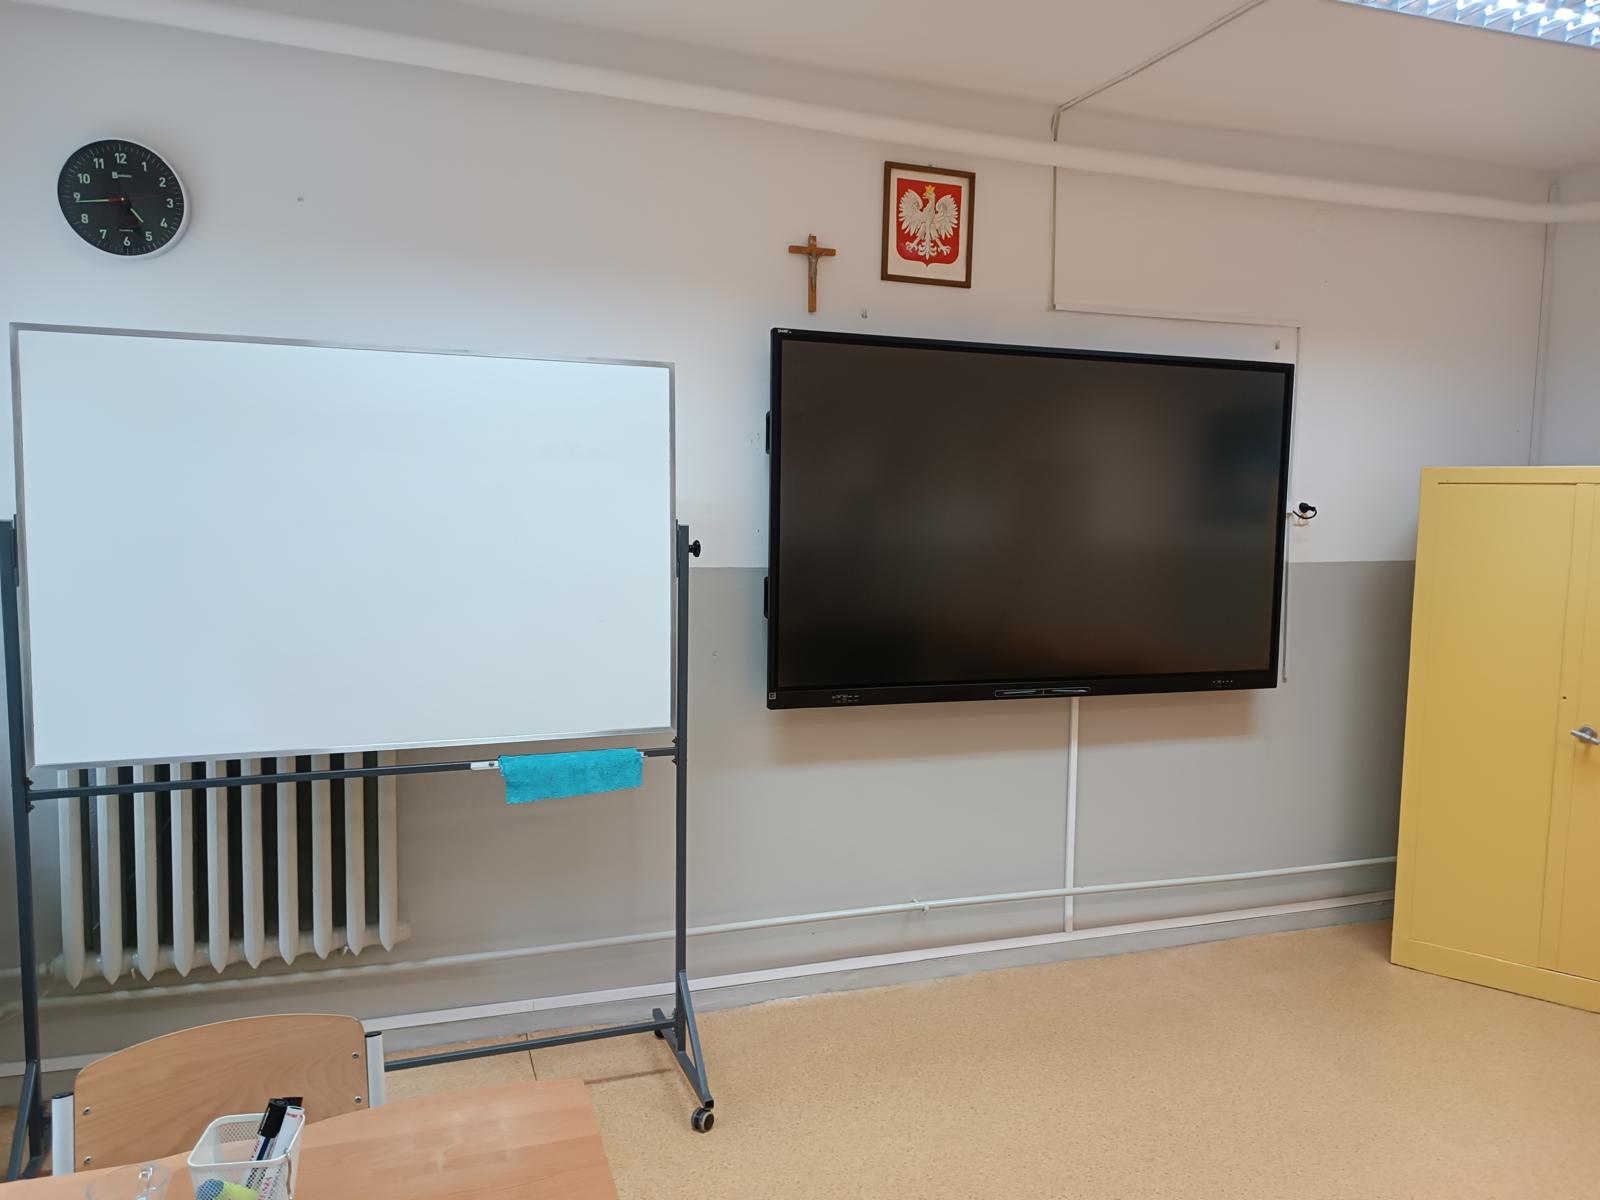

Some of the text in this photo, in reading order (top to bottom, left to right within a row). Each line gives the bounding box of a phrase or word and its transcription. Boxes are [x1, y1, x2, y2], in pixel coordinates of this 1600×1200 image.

[93, 158, 104, 169] 11
[114, 153, 127, 164] 12
[142, 162, 147, 172] 1
[77, 173, 90, 184] 10
[159, 177, 166, 187] 2
[73, 192, 80, 202] 9
[166, 198, 173, 208] 3
[81, 213, 88, 223] 8
[160, 218, 168, 228] 4
[99, 229, 107, 239] 7
[145, 231, 152, 241] 5
[123, 236, 130, 246] 6
